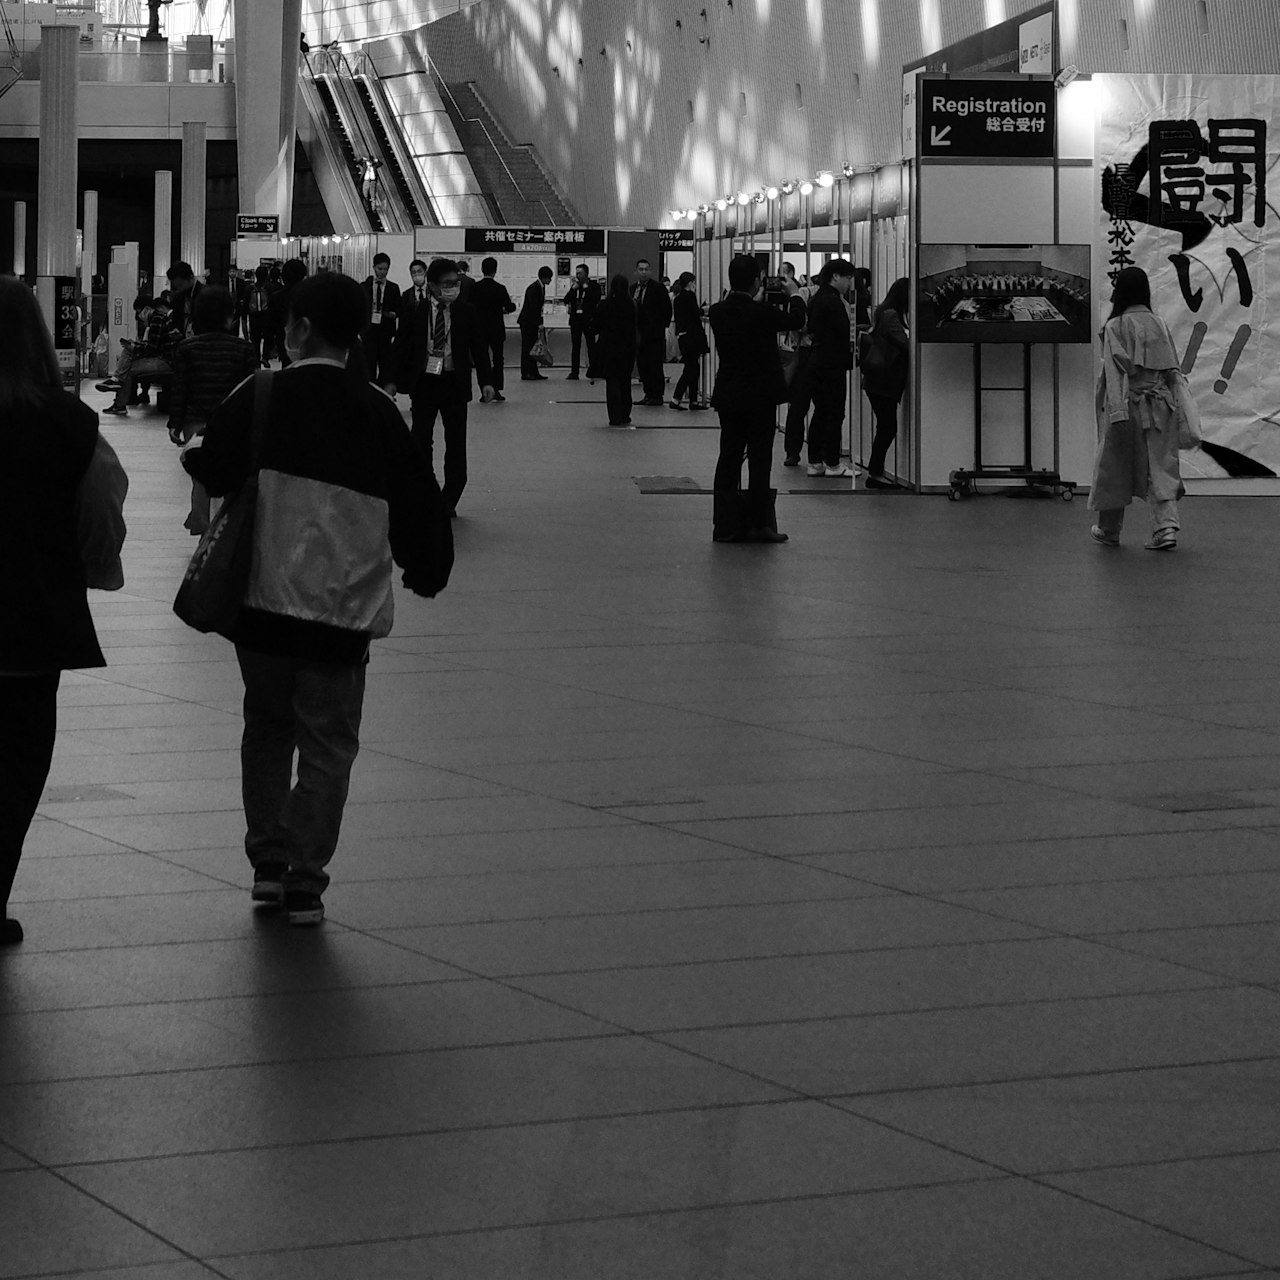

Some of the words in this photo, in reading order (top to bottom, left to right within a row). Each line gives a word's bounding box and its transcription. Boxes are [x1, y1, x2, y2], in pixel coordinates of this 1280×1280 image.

[931, 96, 1046, 116] Registration
[986, 117, 1046, 133] 総合受付
[485, 231, 585, 242] 共催セミナー案内看板
